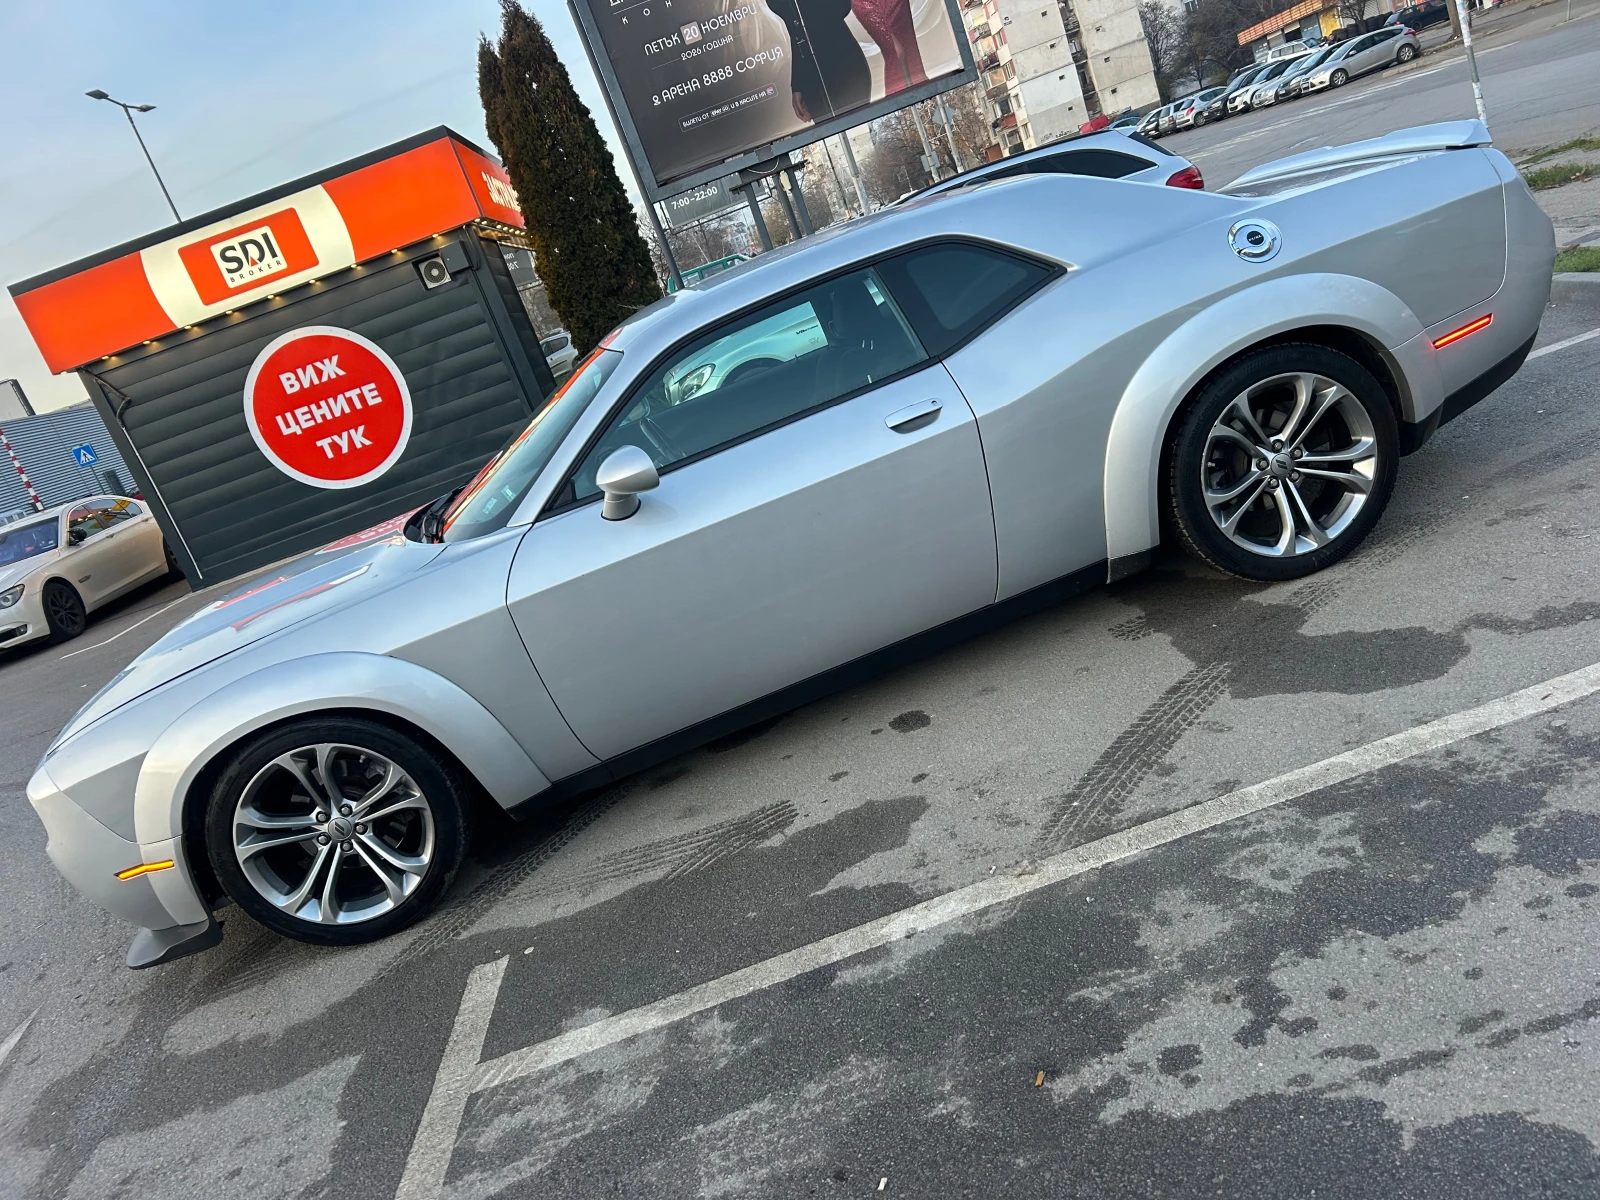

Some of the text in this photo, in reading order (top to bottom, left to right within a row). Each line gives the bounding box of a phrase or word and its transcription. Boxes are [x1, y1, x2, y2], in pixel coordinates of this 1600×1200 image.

[644, 3, 757, 56] ПЕТЪК 20 НОЕМВРИ
[680, 34, 734, 61] 2026 ГОДИНА
[661, 46, 784, 102] АРЕНА 8888 СОФИЯ
[219, 232, 279, 274] SDI
[229, 259, 283, 283] BROKER
[278, 354, 347, 395] ВИЖ
[275, 382, 383, 437] ЦЕНИТЕ
[315, 424, 373, 460] ТУК
